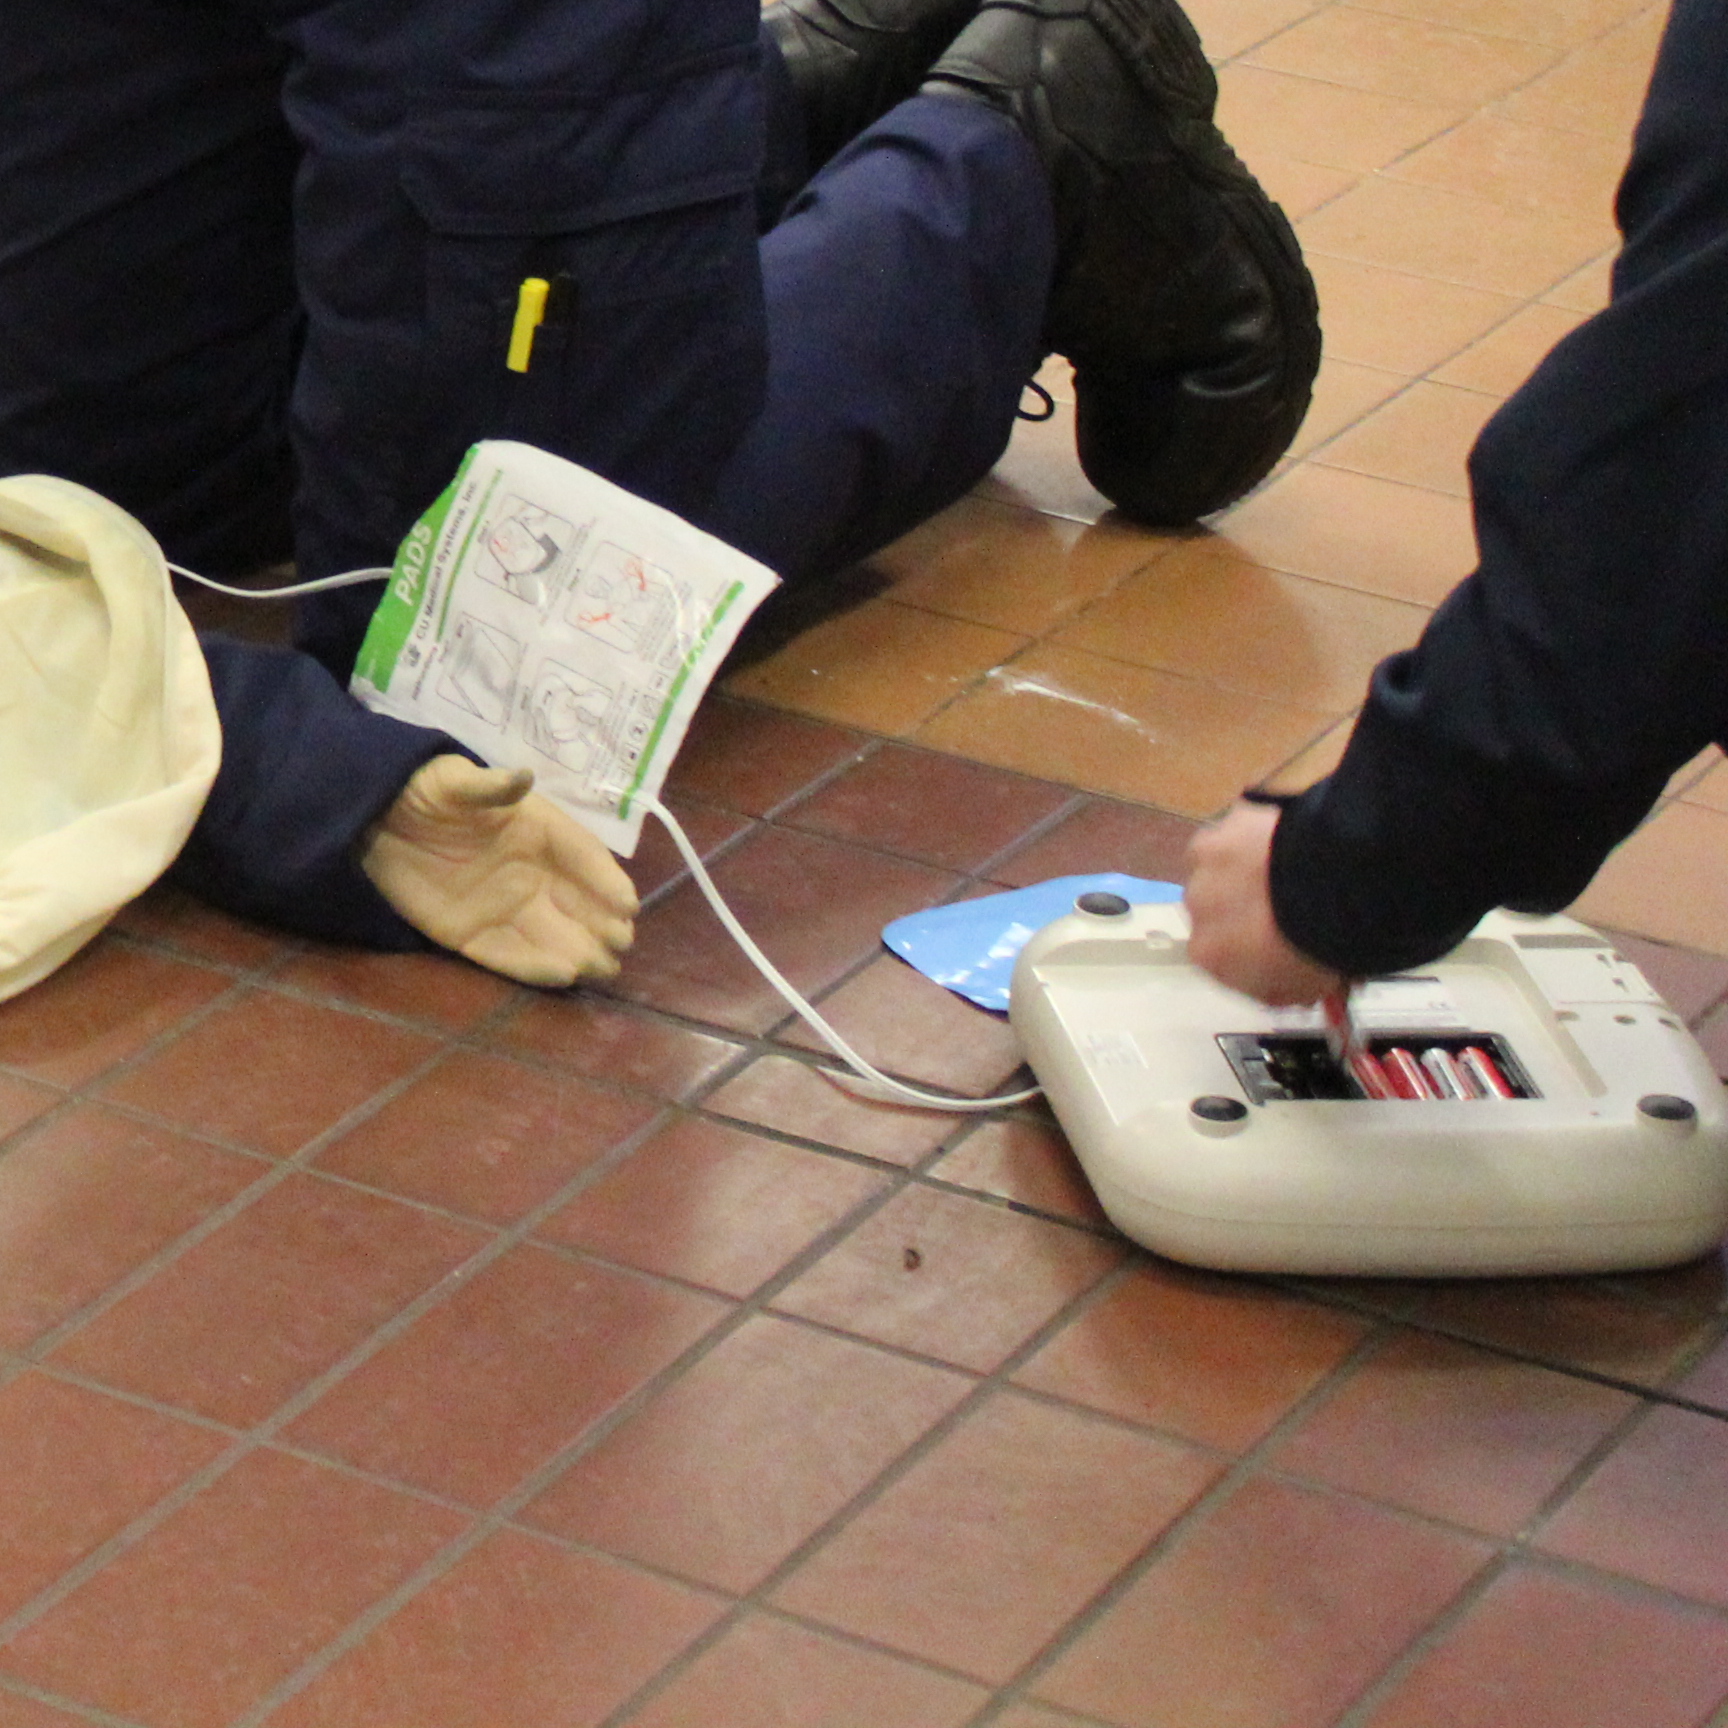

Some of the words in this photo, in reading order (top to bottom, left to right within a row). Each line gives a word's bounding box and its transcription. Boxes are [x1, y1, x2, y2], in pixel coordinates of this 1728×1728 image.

[395, 522, 433, 607] PADS
[416, 619, 430, 640] CU
[425, 566, 442, 618] Medical
